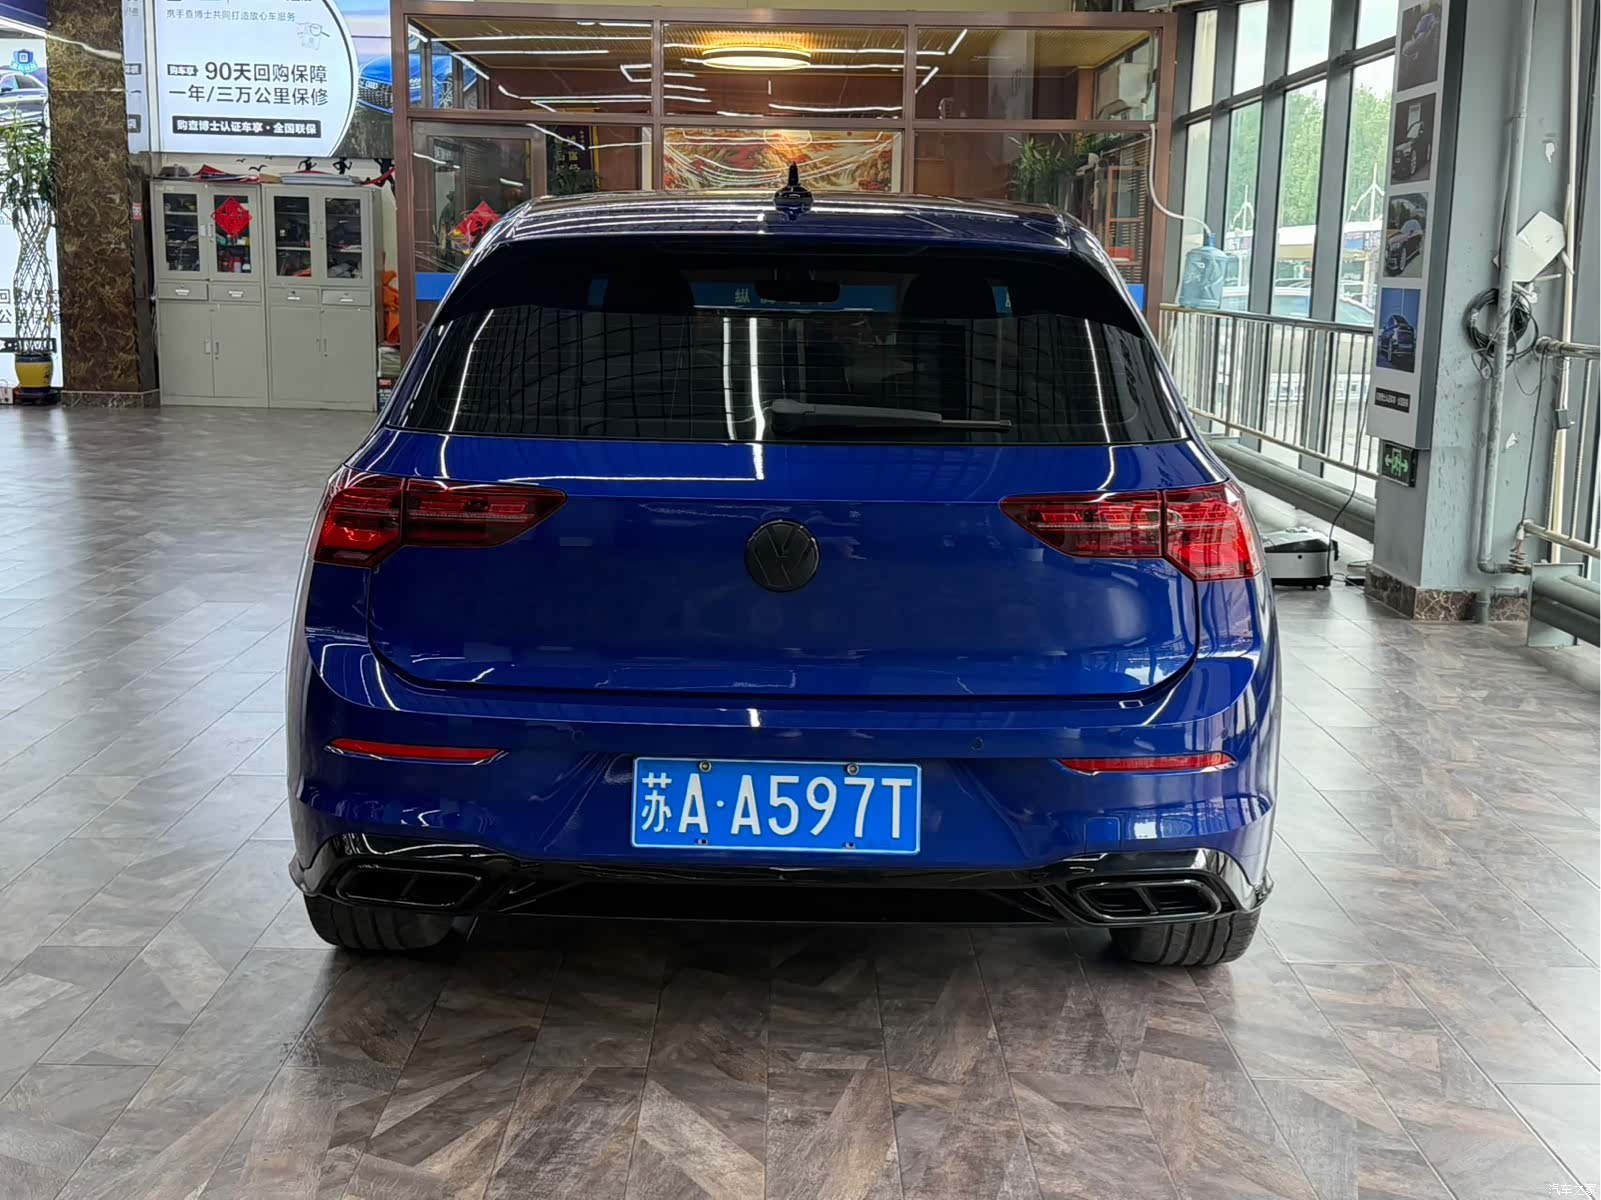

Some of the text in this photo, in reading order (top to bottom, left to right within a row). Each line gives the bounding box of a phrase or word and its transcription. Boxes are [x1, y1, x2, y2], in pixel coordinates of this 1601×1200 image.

[205, 61, 328, 84] 90天回购保障
[169, 84, 329, 106] 一年/三万公里保修
[641, 772, 912, 839] 苏A·A597T
